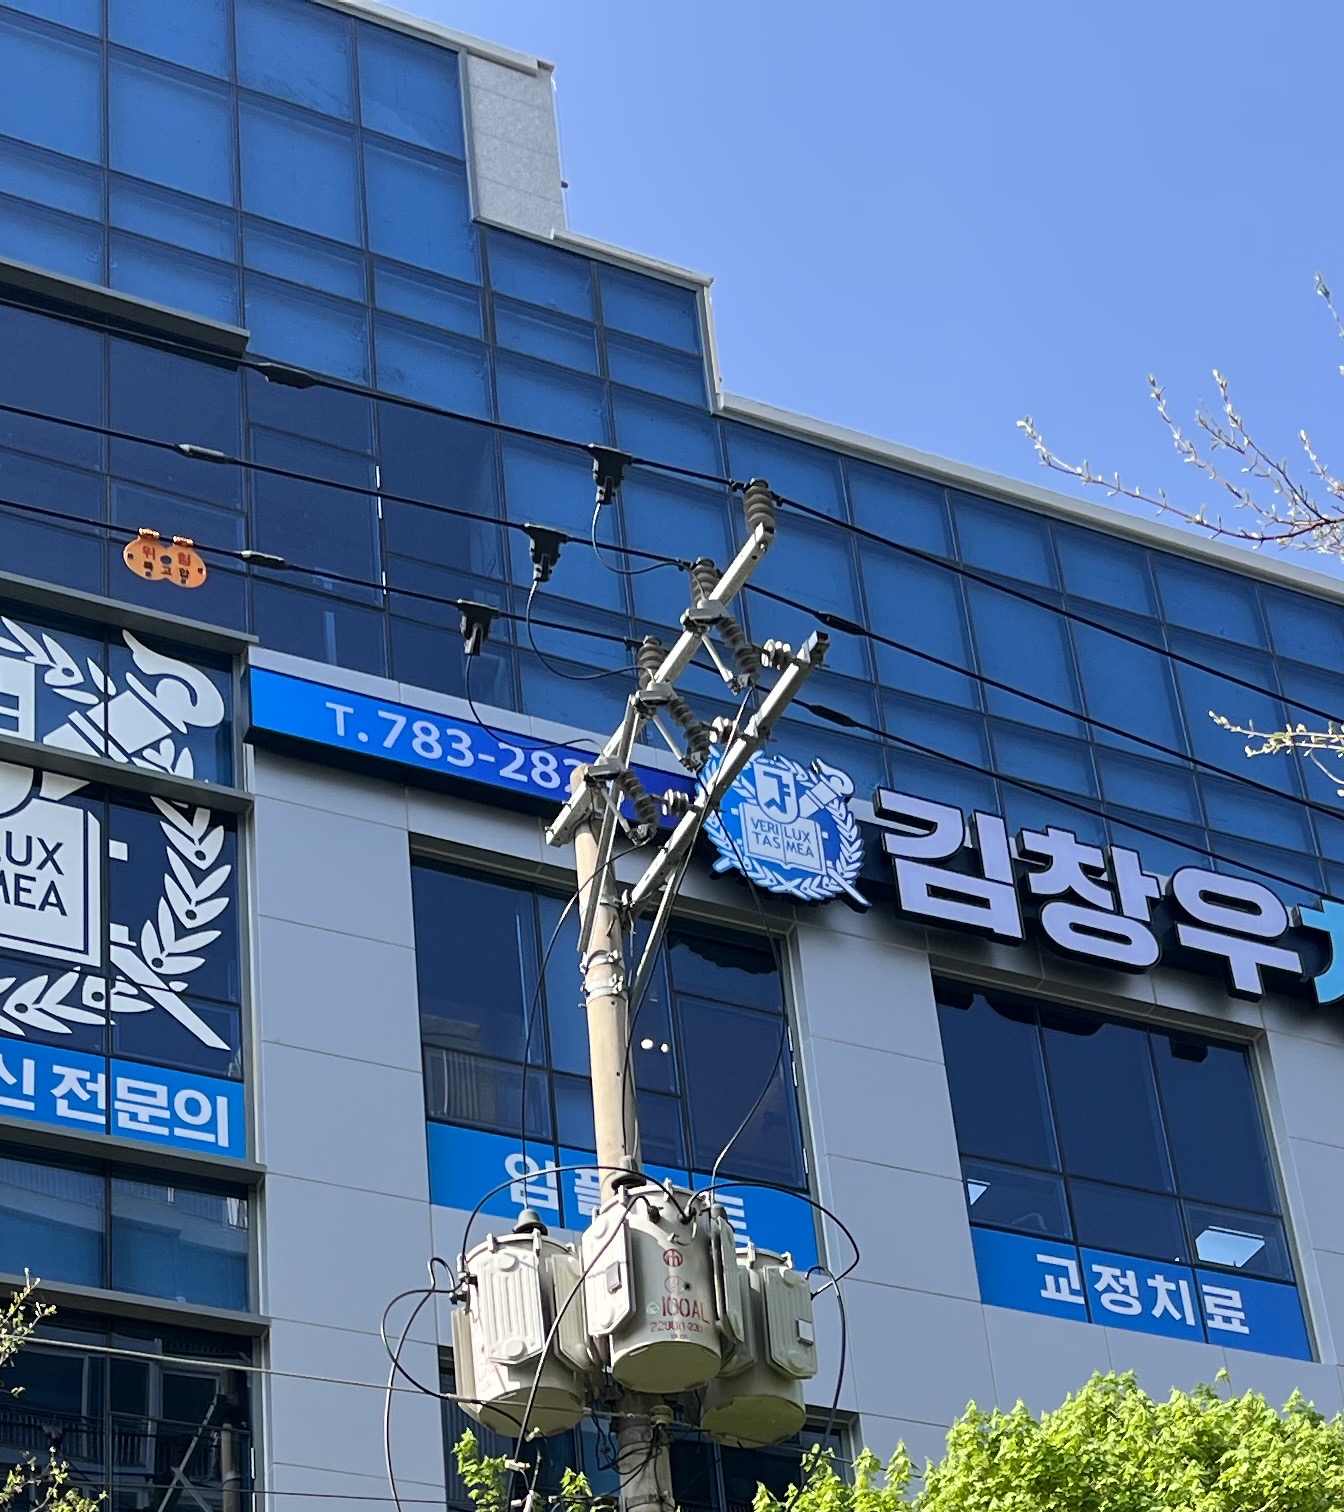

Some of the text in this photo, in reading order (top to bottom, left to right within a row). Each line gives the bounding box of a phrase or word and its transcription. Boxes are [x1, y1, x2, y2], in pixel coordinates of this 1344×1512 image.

[751, 817, 810, 843] VERI LUX
[752, 831, 814, 858] TAS MEA
[50, 1062, 229, 1149] 전문의
[1036, 1254, 1250, 1335] 교정치료
